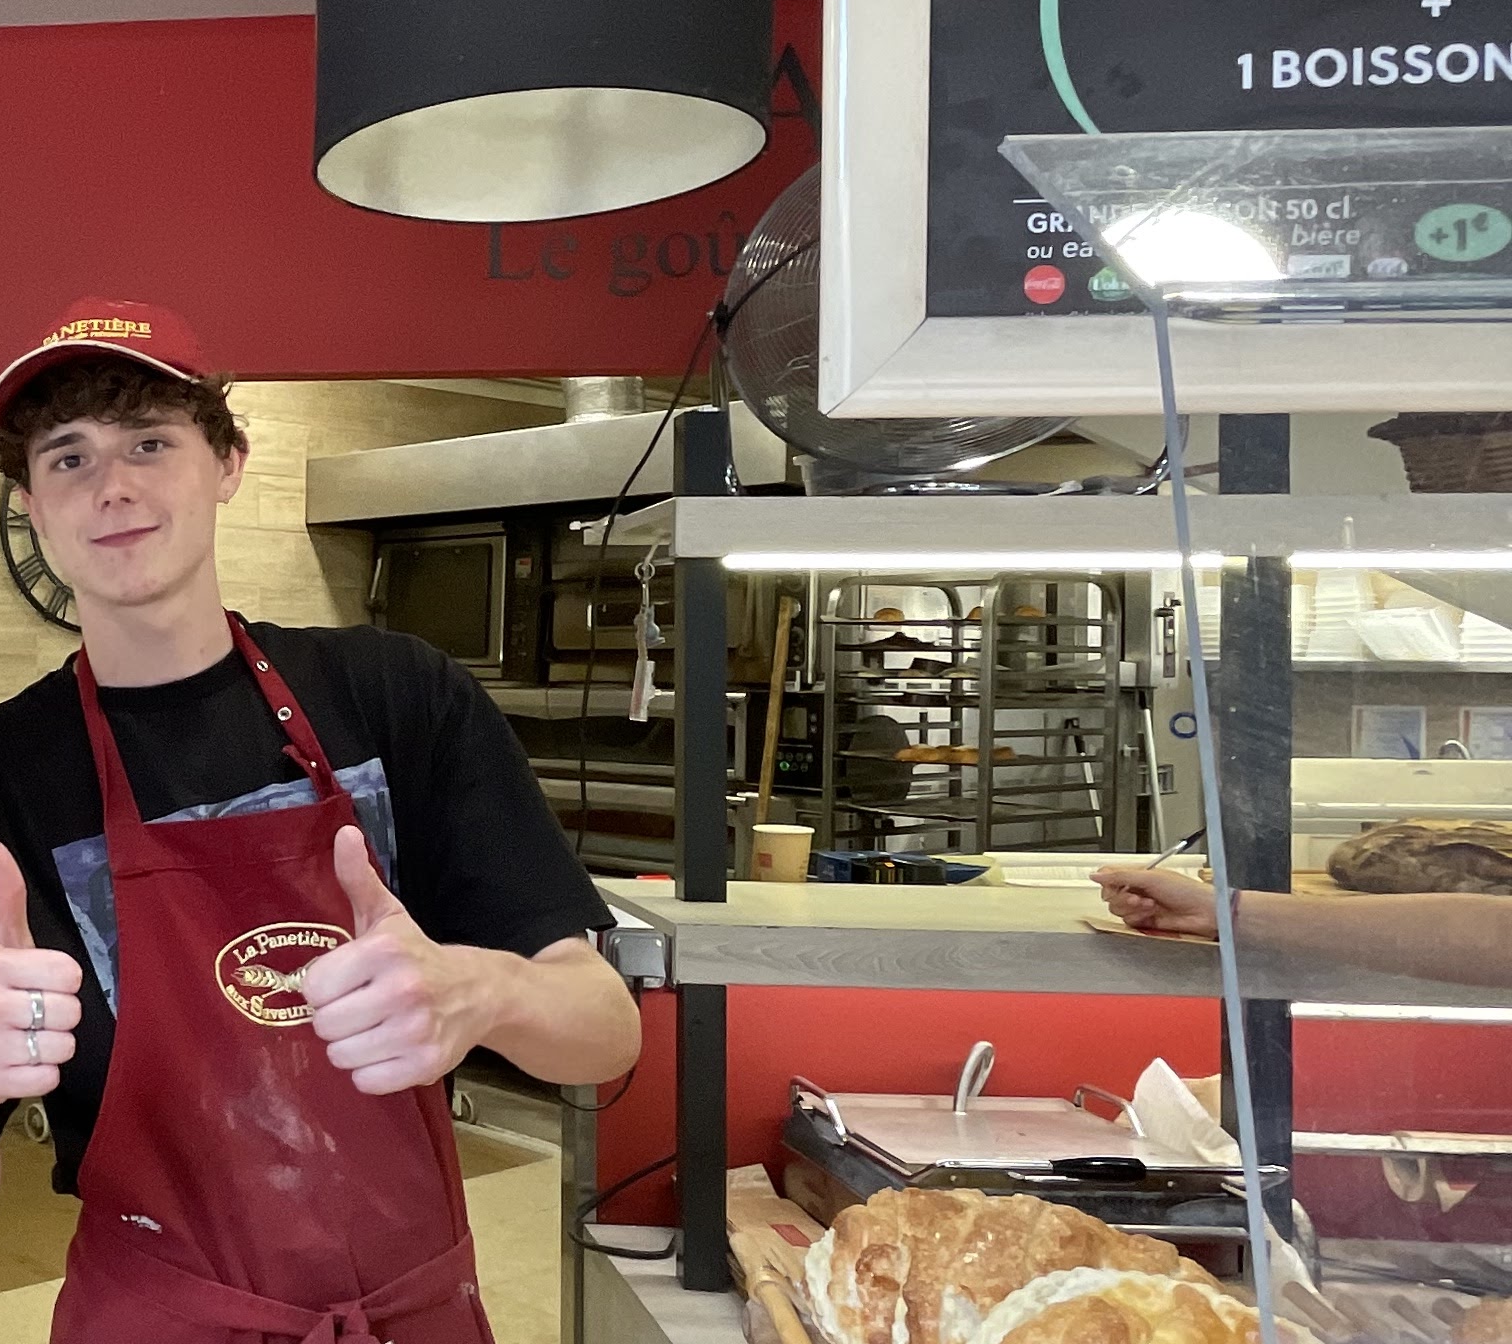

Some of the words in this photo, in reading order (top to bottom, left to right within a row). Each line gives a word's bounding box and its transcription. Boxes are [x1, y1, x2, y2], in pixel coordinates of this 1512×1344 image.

[1236, 52, 1254, 90] 1
[607, 211, 745, 297] goû
[1026, 243, 1054, 260] ou
[1062, 240, 1096, 259] ea
[232, 944, 259, 965] La
